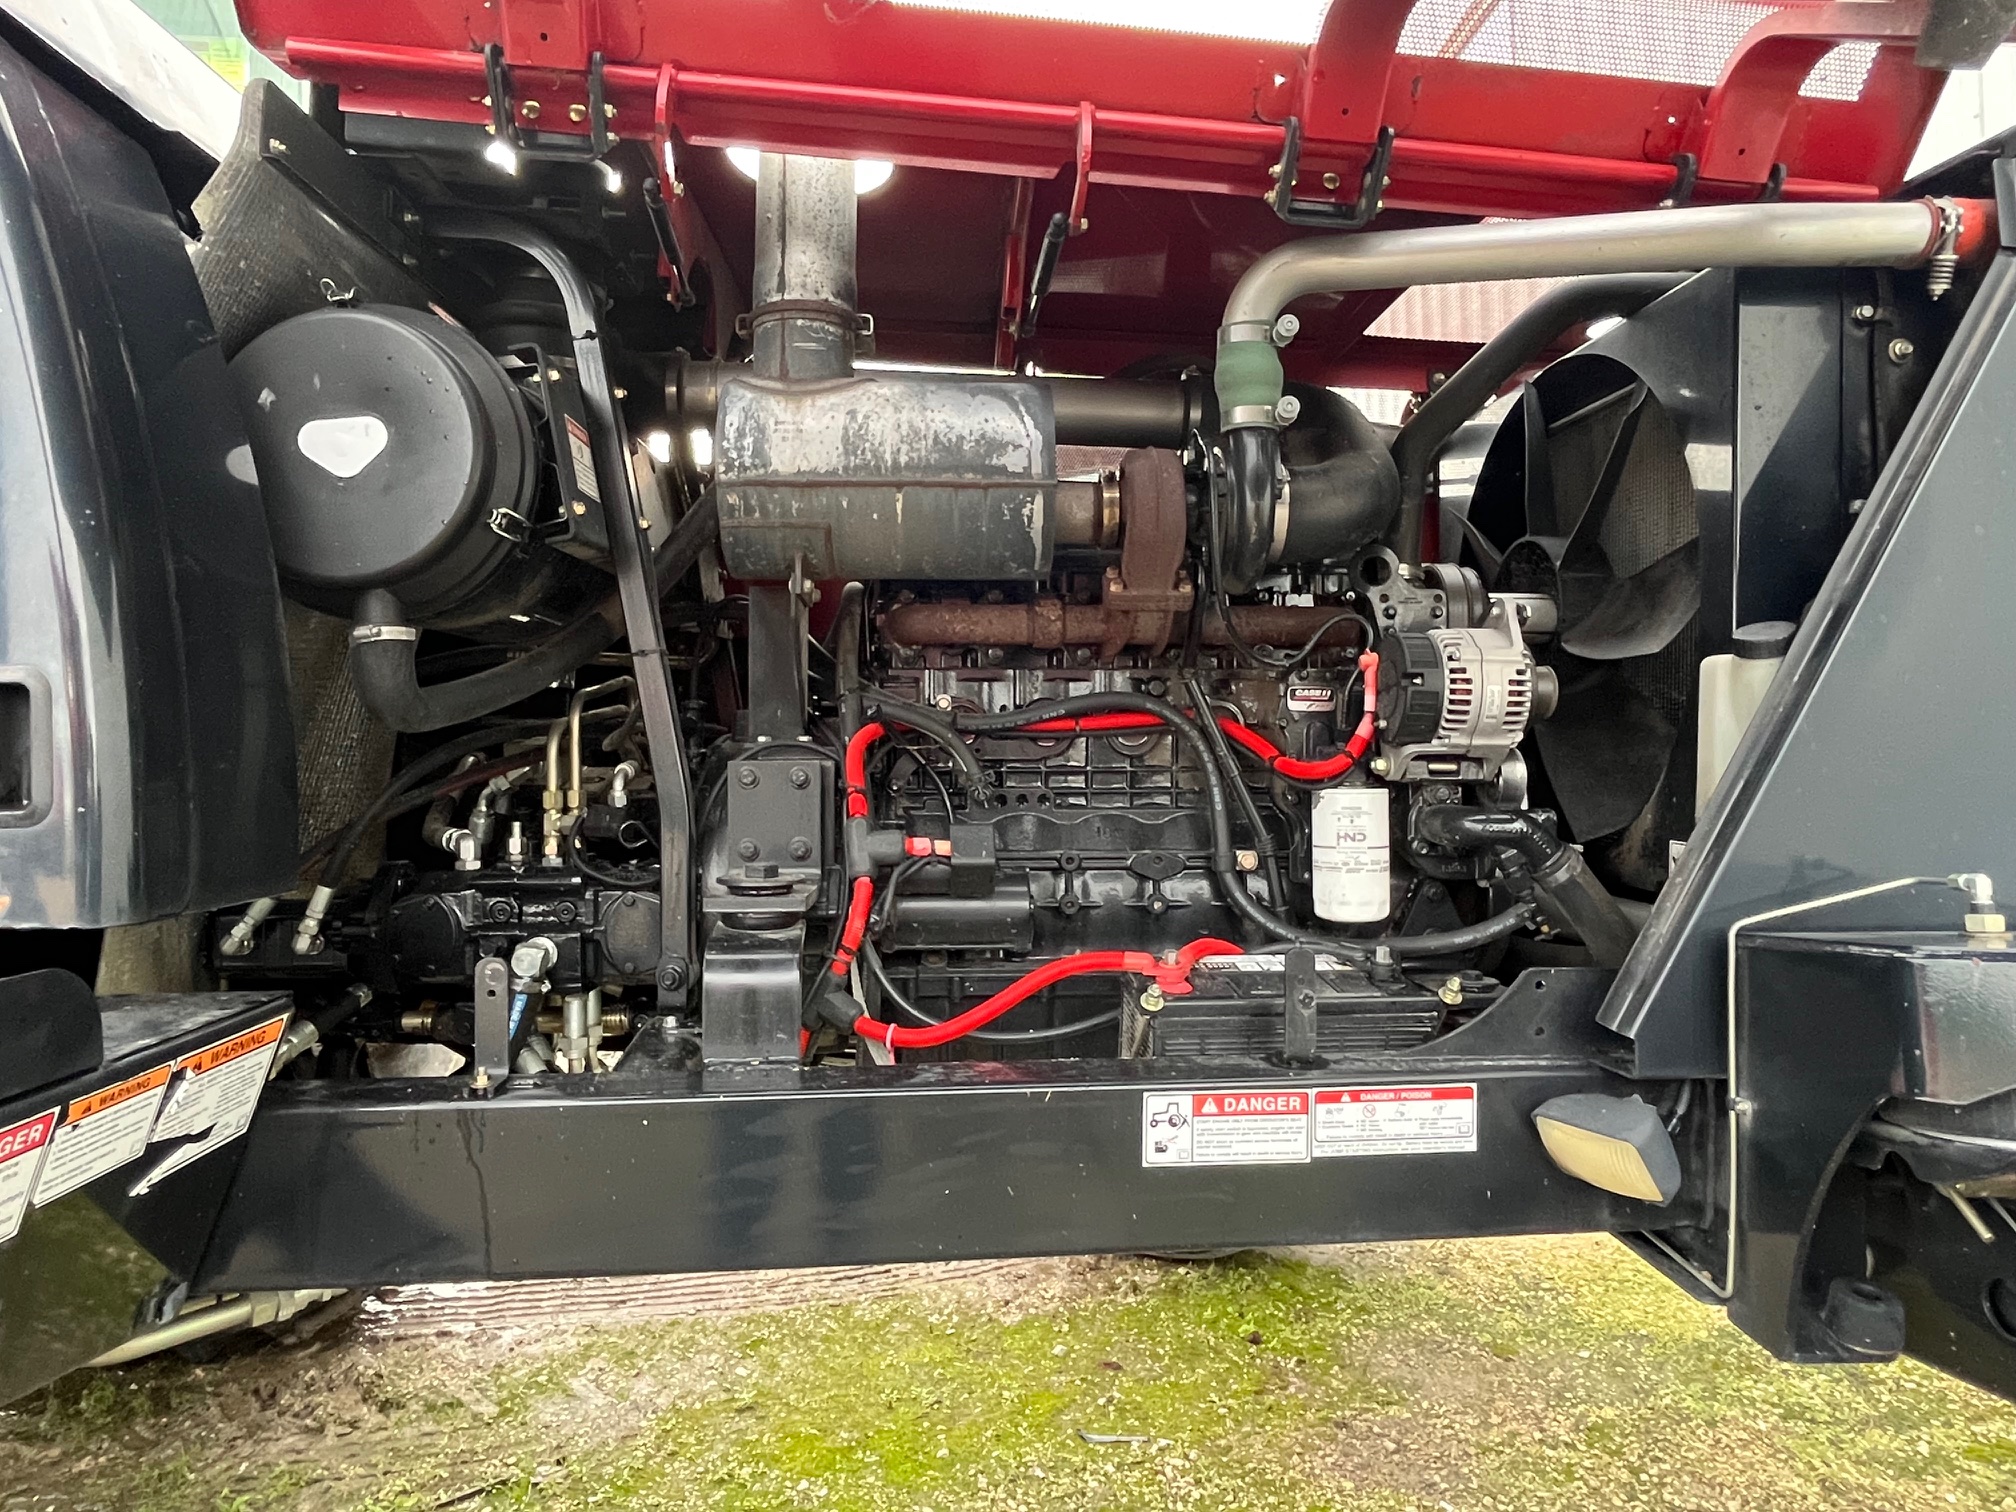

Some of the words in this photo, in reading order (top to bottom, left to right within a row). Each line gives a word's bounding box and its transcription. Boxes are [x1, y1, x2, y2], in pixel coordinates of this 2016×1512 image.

[1336, 832, 1366, 846] CNH
[209, 1030, 267, 1065] WARNING
[99, 1077, 151, 1107] WARNING
[1360, 1093, 1395, 1101] DANGER
[1401, 1091, 1432, 1099] POISON
[1224, 1096, 1301, 1112] DANGER
